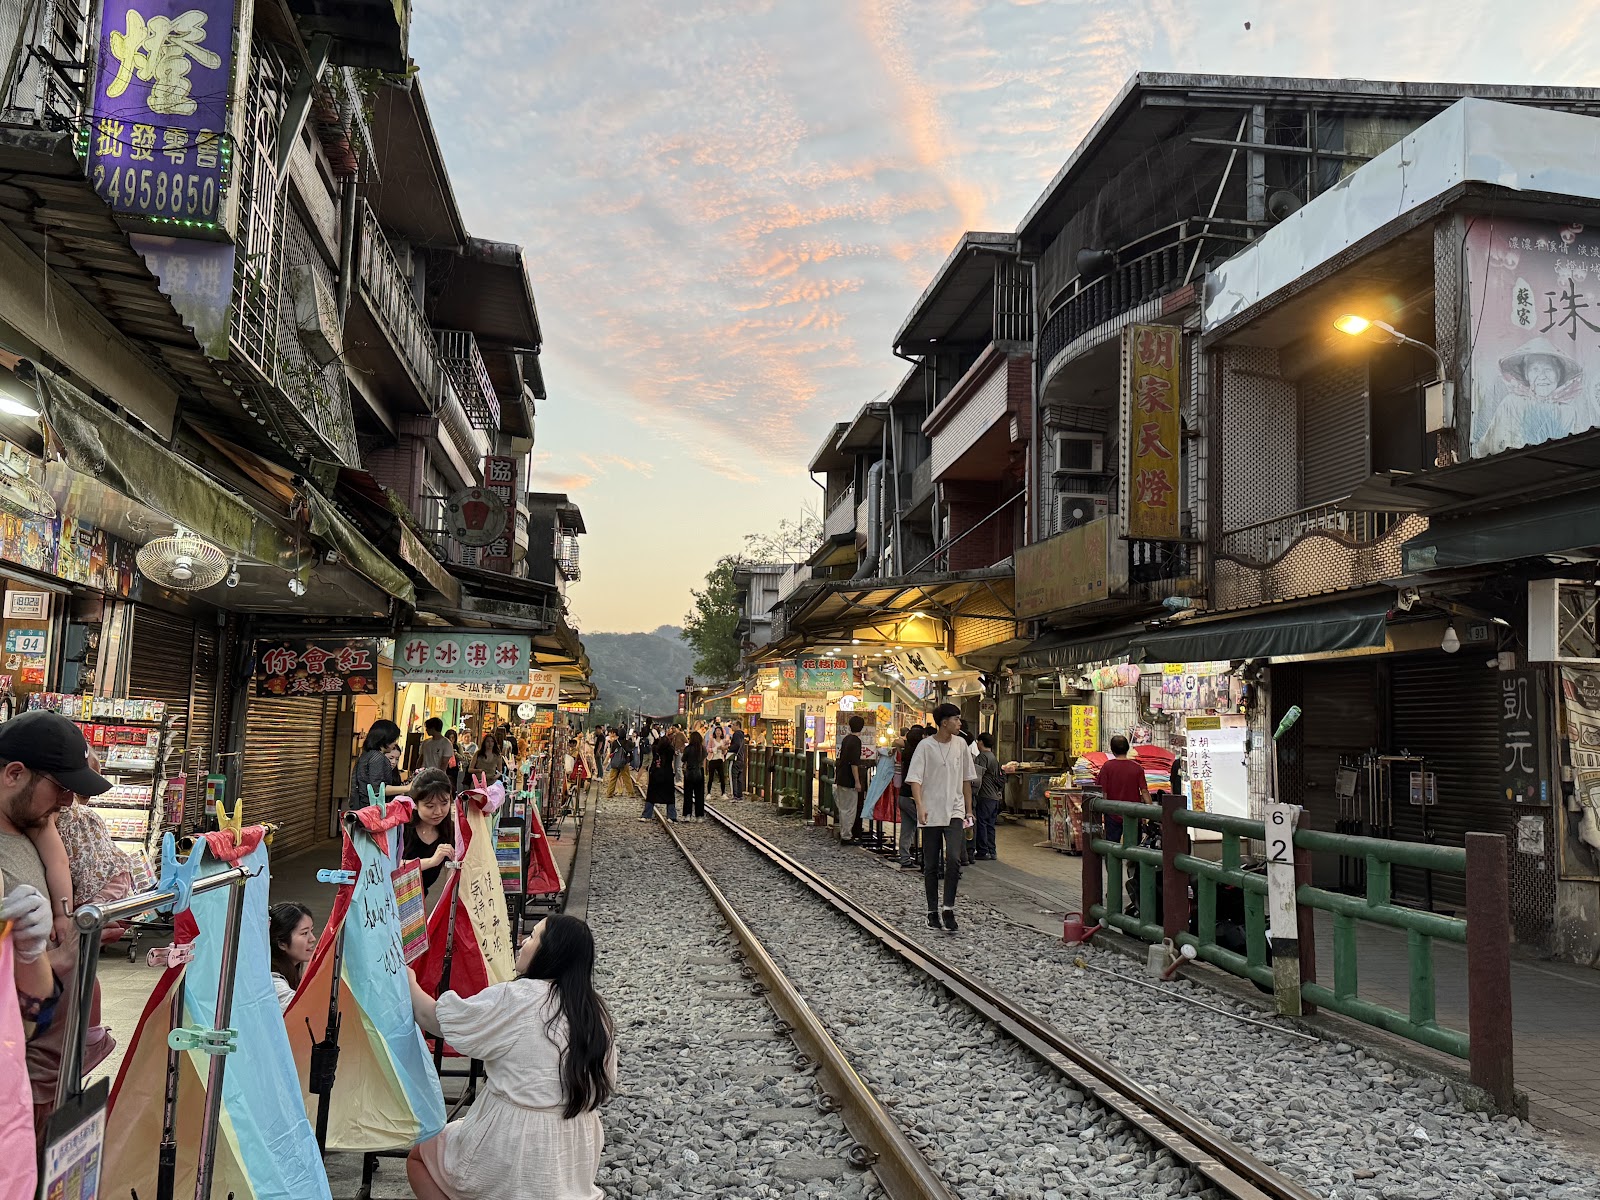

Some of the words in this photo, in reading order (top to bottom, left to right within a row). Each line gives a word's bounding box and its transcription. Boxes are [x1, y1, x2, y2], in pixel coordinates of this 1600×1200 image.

[95, 118, 219, 169] 批發零售
[1517, 288, 1532, 326] 蘇家
[1540, 277, 1600, 341] 珠
[1135, 328, 1176, 508] 胡家天燈
[22, 638, 38, 650] 94
[262, 646, 372, 675] 你會紅
[405, 641, 519, 665] 炸冰淇淋
[802, 660, 847, 670] 花枝燒
[292, 677, 344, 692] 天燈
[1083, 707, 1094, 749] 胡家天燈
[1503, 677, 1534, 774] 凱元
[1199, 737, 1213, 779] 胡家天燈
[1272, 811, 1284, 825] 6
[1272, 839, 1287, 862] 2
